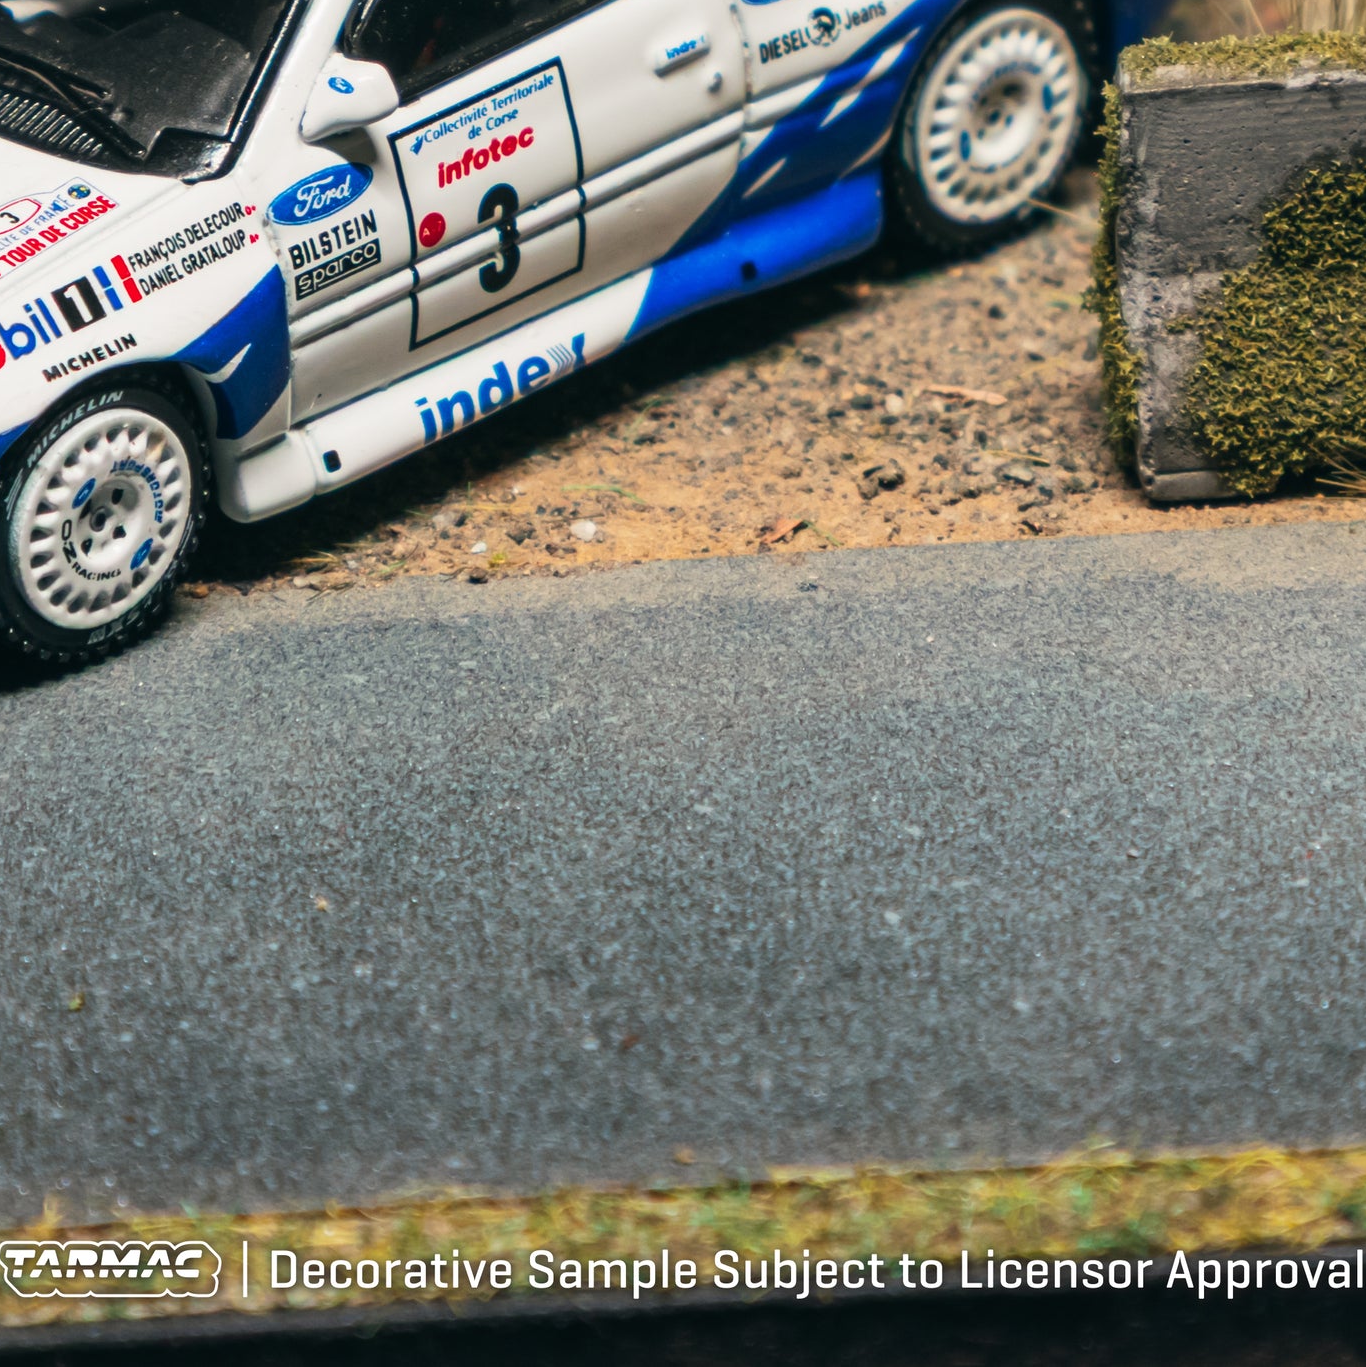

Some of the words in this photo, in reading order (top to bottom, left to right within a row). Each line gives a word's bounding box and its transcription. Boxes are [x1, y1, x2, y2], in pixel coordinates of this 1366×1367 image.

[759, 29, 809, 64] DIESEL
[844, 1, 887, 30] Jeans
[424, 103, 487, 143] Collectivité
[491, 74, 554, 111] Territoriale
[468, 125, 482, 140] de
[486, 109, 519, 131] Corse
[438, 126, 534, 188] infotec
[0, 212, 20, 224] 3
[38, 224, 67, 244] DE
[59, 195, 116, 230] CORSE
[294, 174, 352, 217] Ford
[19, 225, 33, 236] DE
[128, 232, 186, 272] FRANÇOIS
[183, 202, 245, 245] DELECOUR
[288, 209, 377, 270] BILSTEIN
[477, 183, 521, 293] 3
[139, 263, 183, 296] DANIEL
[181, 229, 246, 275] GRATALOUP
[298, 243, 376, 291] sparco
[42, 333, 138, 383] MICHELIN
[27, 391, 124, 468] MICHELIN
